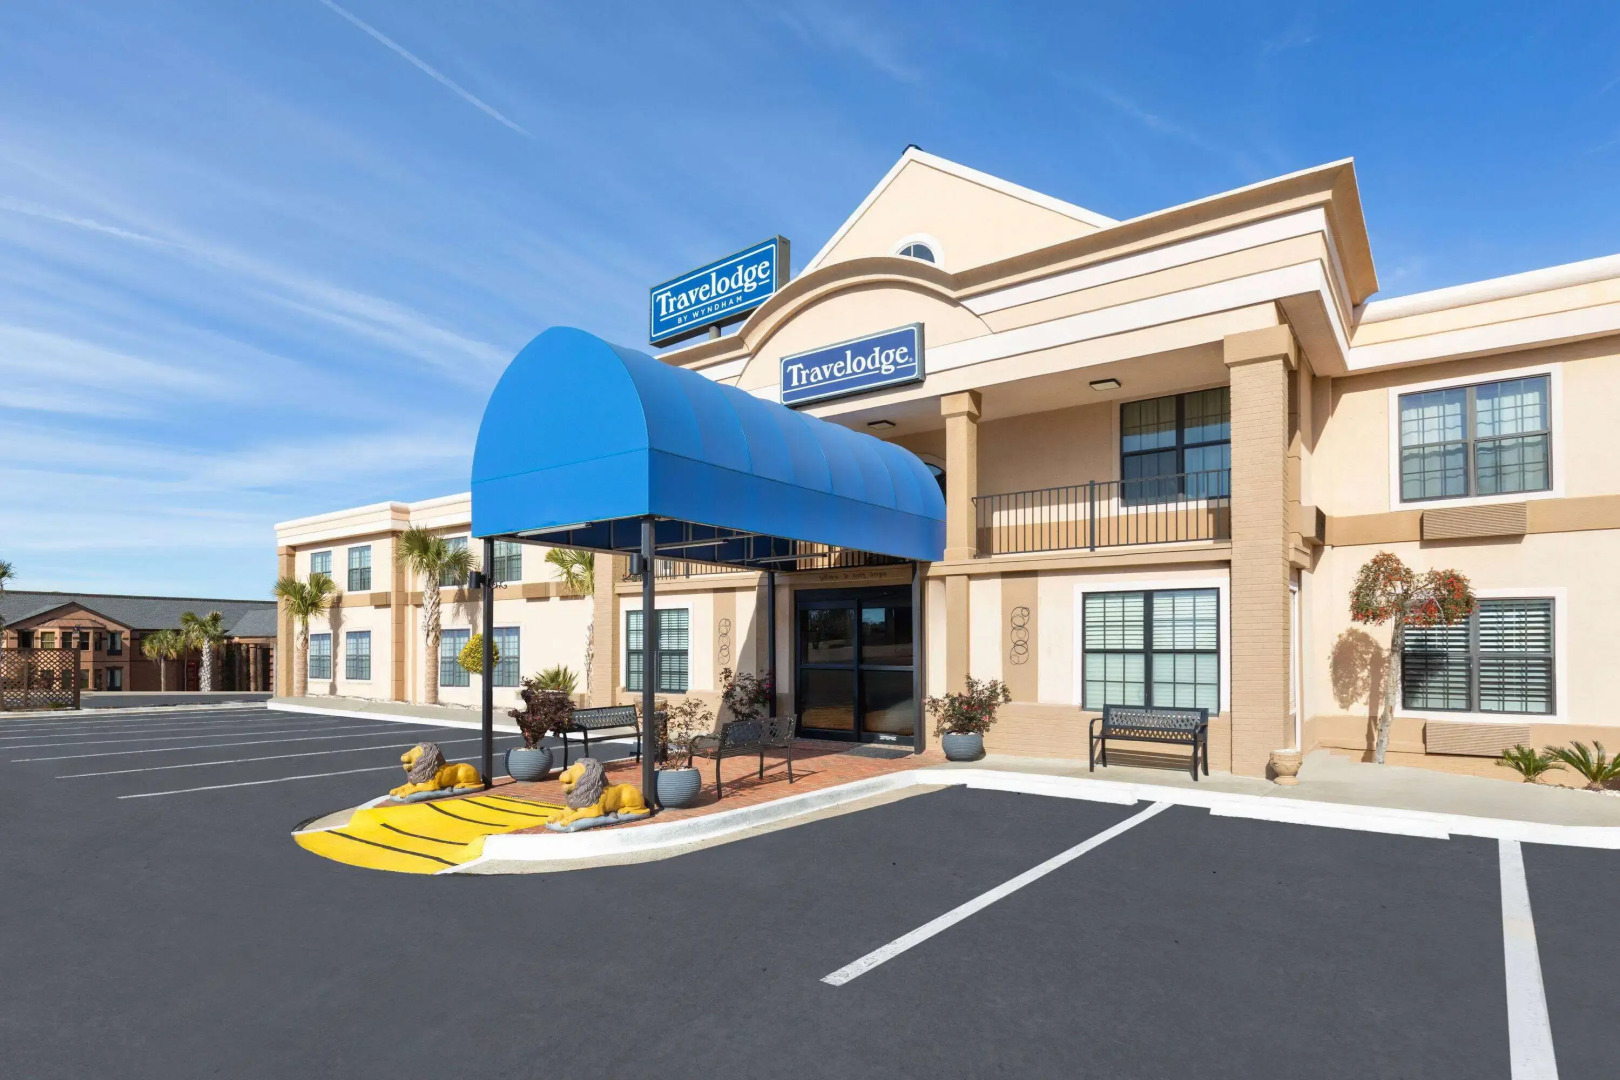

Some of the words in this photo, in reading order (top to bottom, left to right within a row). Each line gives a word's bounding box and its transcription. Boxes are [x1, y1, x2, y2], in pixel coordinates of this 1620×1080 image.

[656, 260, 771, 317] Travelodge
[677, 315, 688, 324] BY
[692, 295, 743, 319] WYNDHAM
[786, 346, 909, 387] Travelodge
